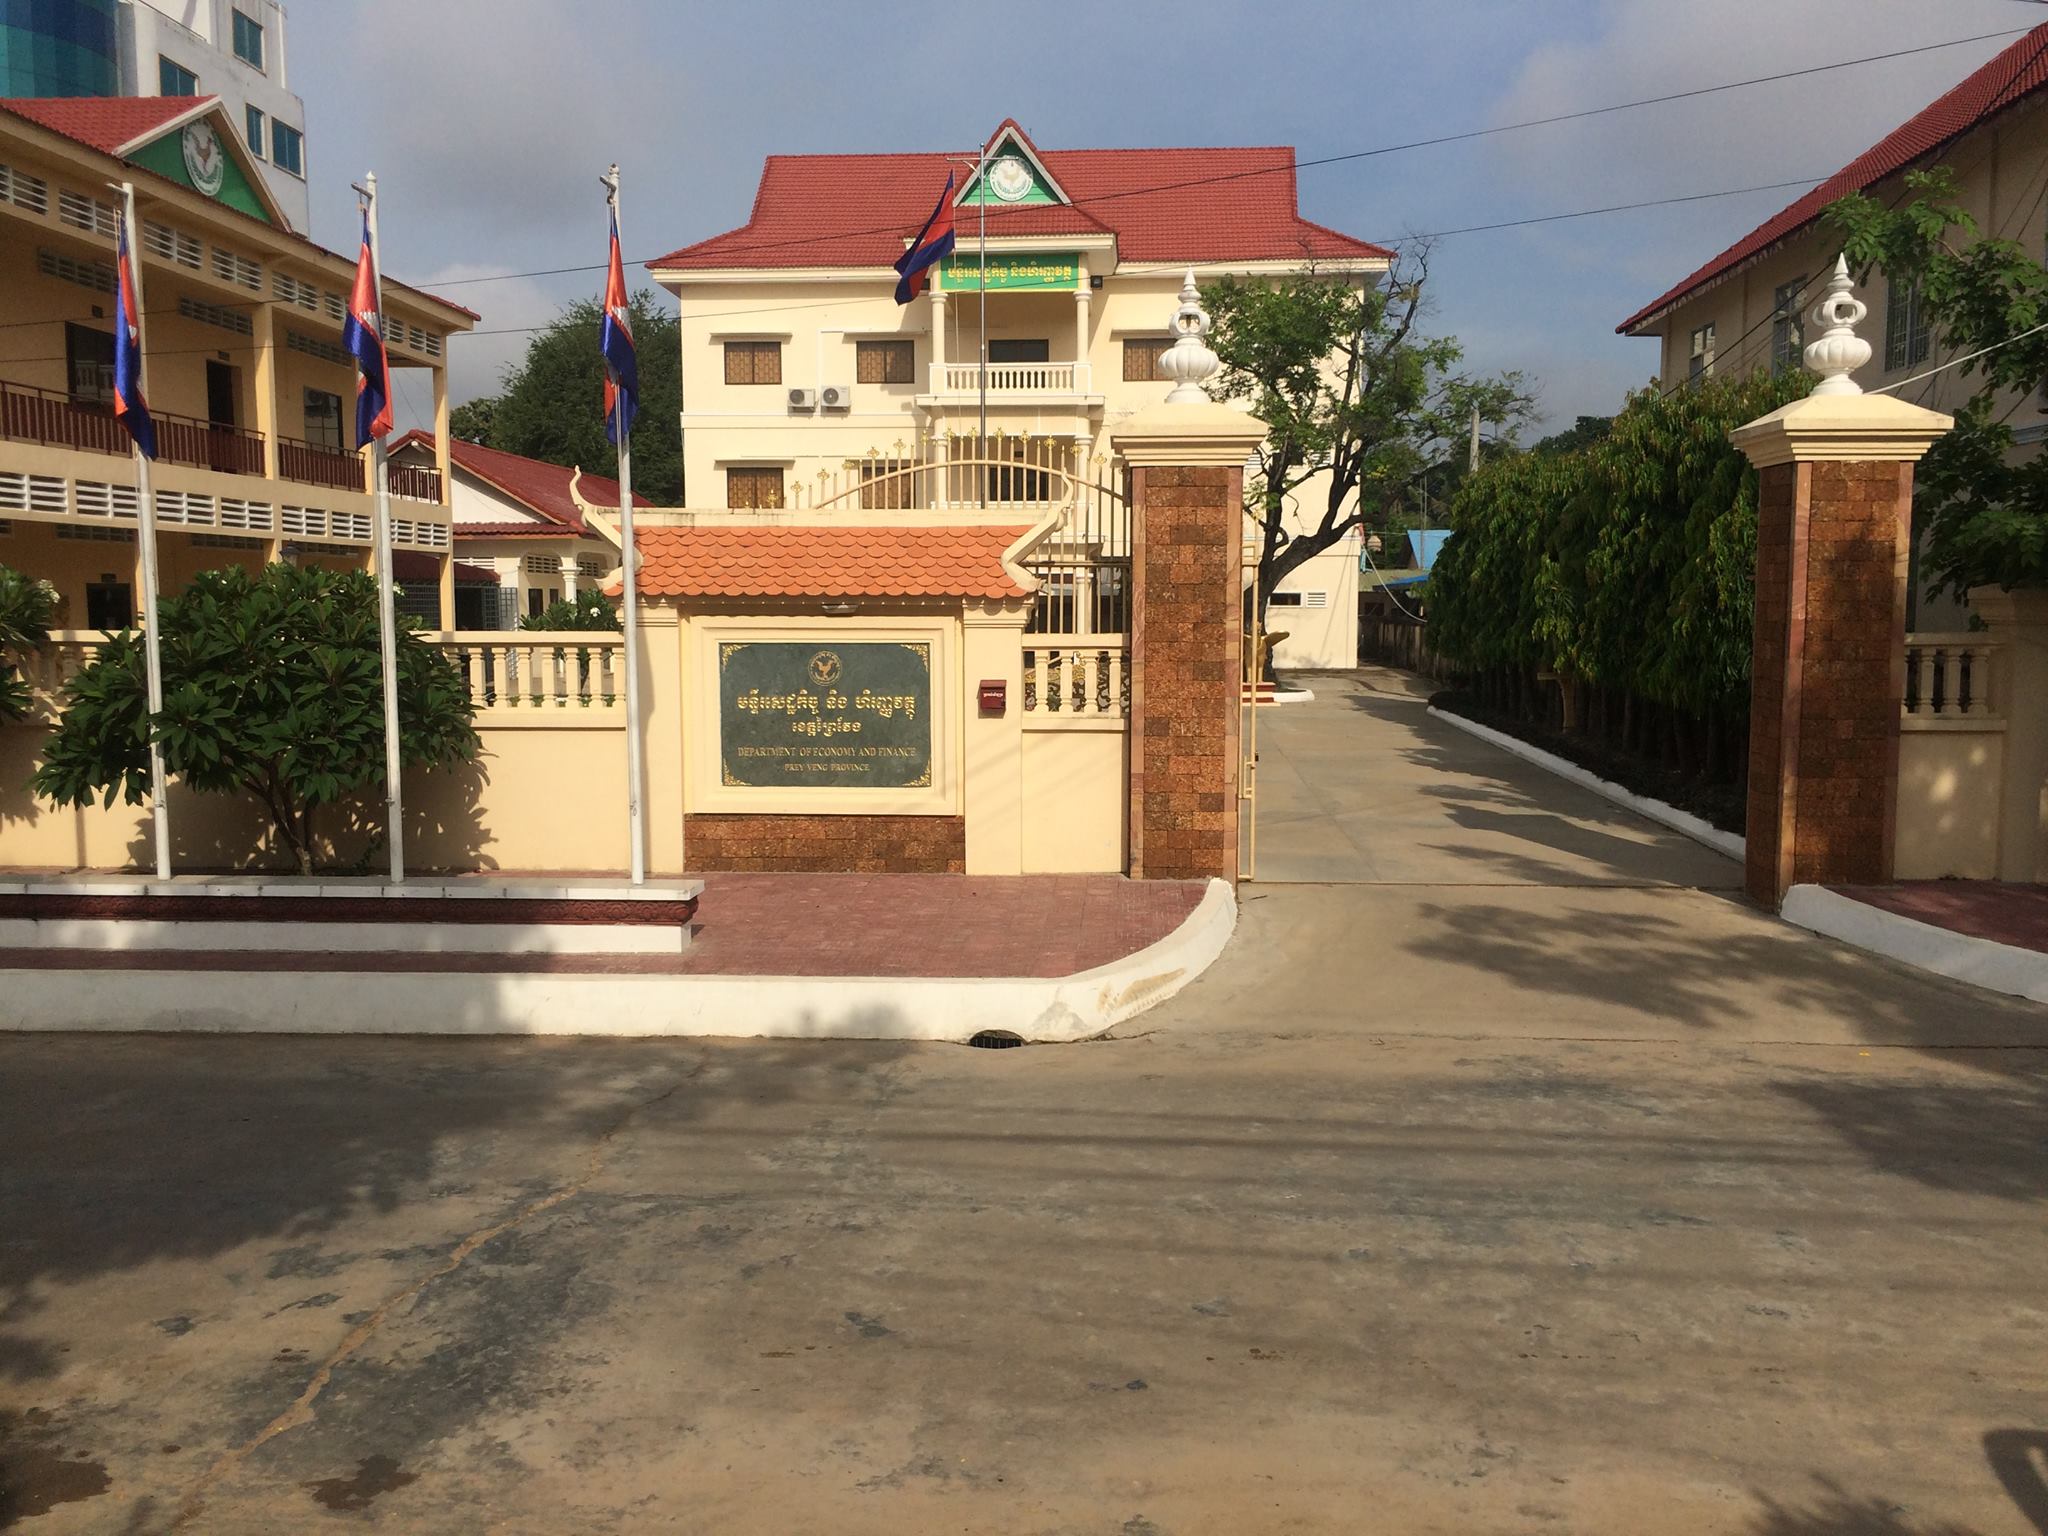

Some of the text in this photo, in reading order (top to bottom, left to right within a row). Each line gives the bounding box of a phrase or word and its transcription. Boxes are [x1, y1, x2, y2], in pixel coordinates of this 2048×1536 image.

[825, 689, 848, 710] និង
[792, 716, 862, 737] ខេត្តព្រៃវែង
[737, 746, 917, 757] DEPARTMENT OF ECONOMY AND FINANCE
[784, 763, 871, 772] PREY VENG PROVINCE
